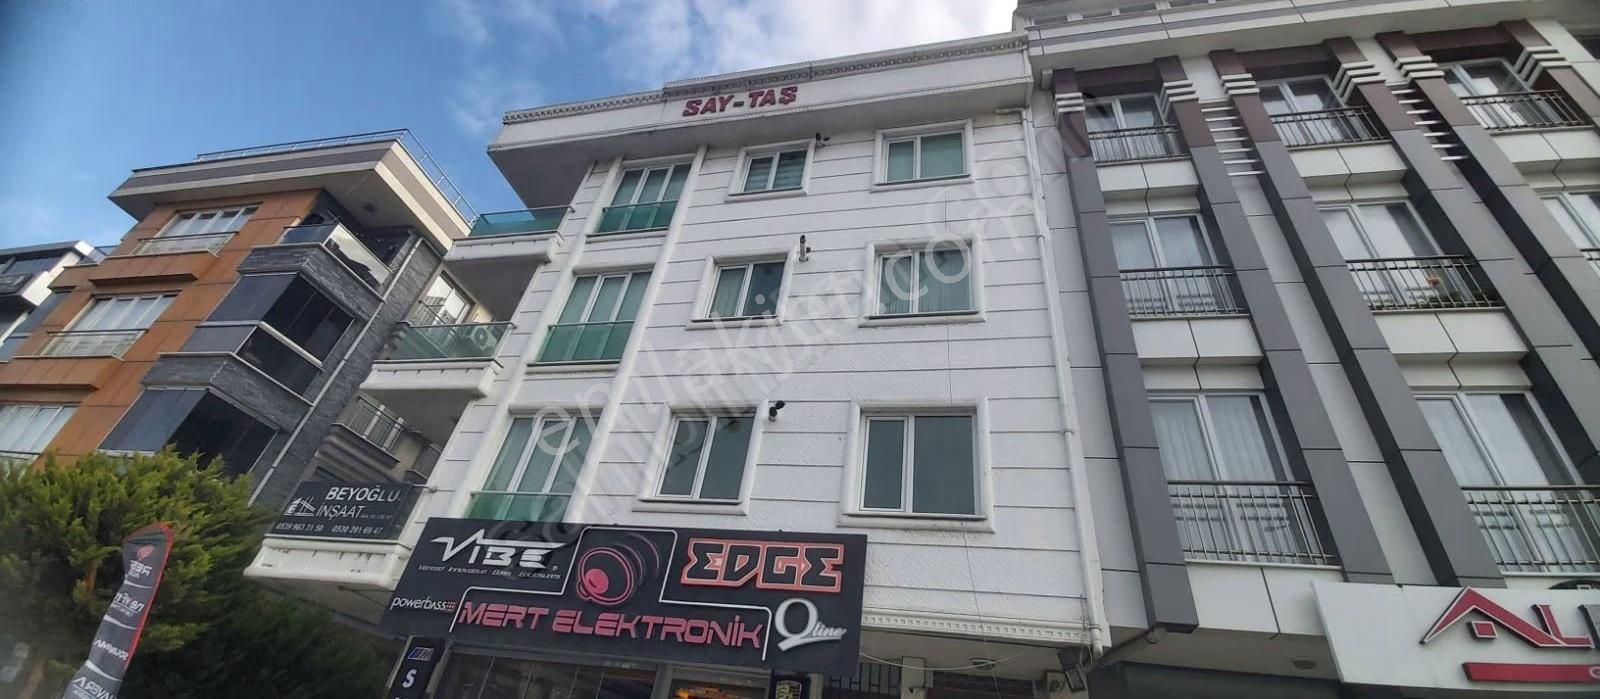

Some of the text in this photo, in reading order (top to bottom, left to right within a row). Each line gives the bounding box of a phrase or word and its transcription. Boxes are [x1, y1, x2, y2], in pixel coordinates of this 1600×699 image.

[316, 501, 366, 521] İNŞAAT
[325, 484, 401, 502] BEYOĞLU
[431, 528, 569, 569] VIBE
[681, 537, 845, 593] EDGE
[458, 600, 766, 649] MERT ELEKTRONİK
